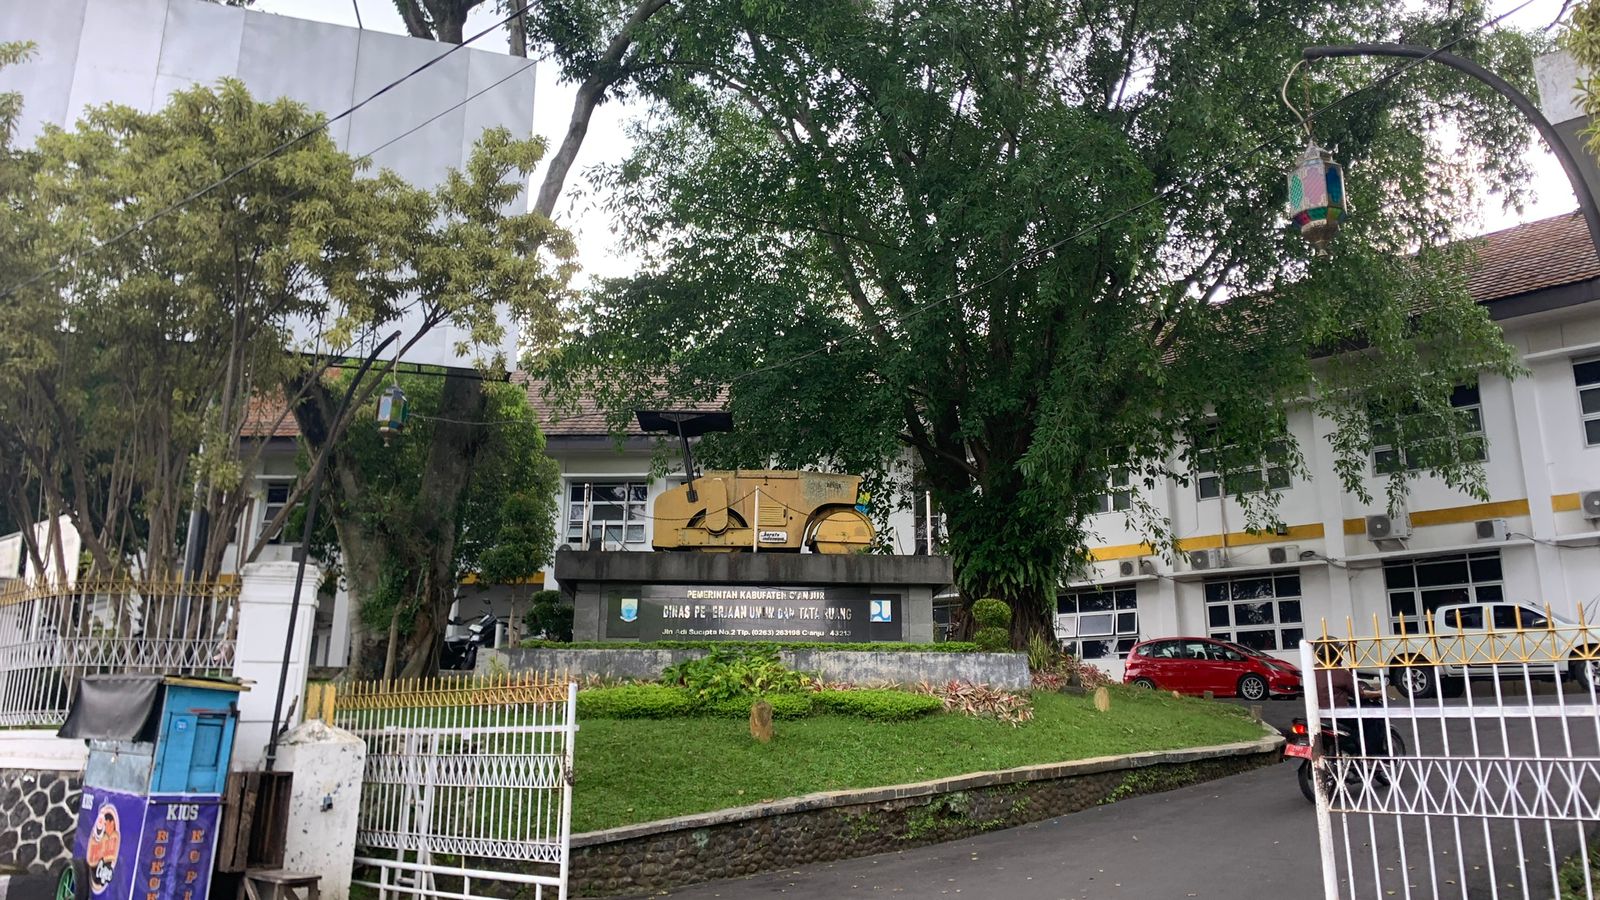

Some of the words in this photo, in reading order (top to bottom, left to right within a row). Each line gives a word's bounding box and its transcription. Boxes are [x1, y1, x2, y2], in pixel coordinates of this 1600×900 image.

[687, 590, 737, 599] PEMERINTAH
[663, 605, 691, 618] DINAS
[694, 605, 747, 619] PEERJAAN
[799, 607, 820, 619] TATA
[751, 629, 774, 637] (0263)
[166, 803, 199, 821] KIDS
